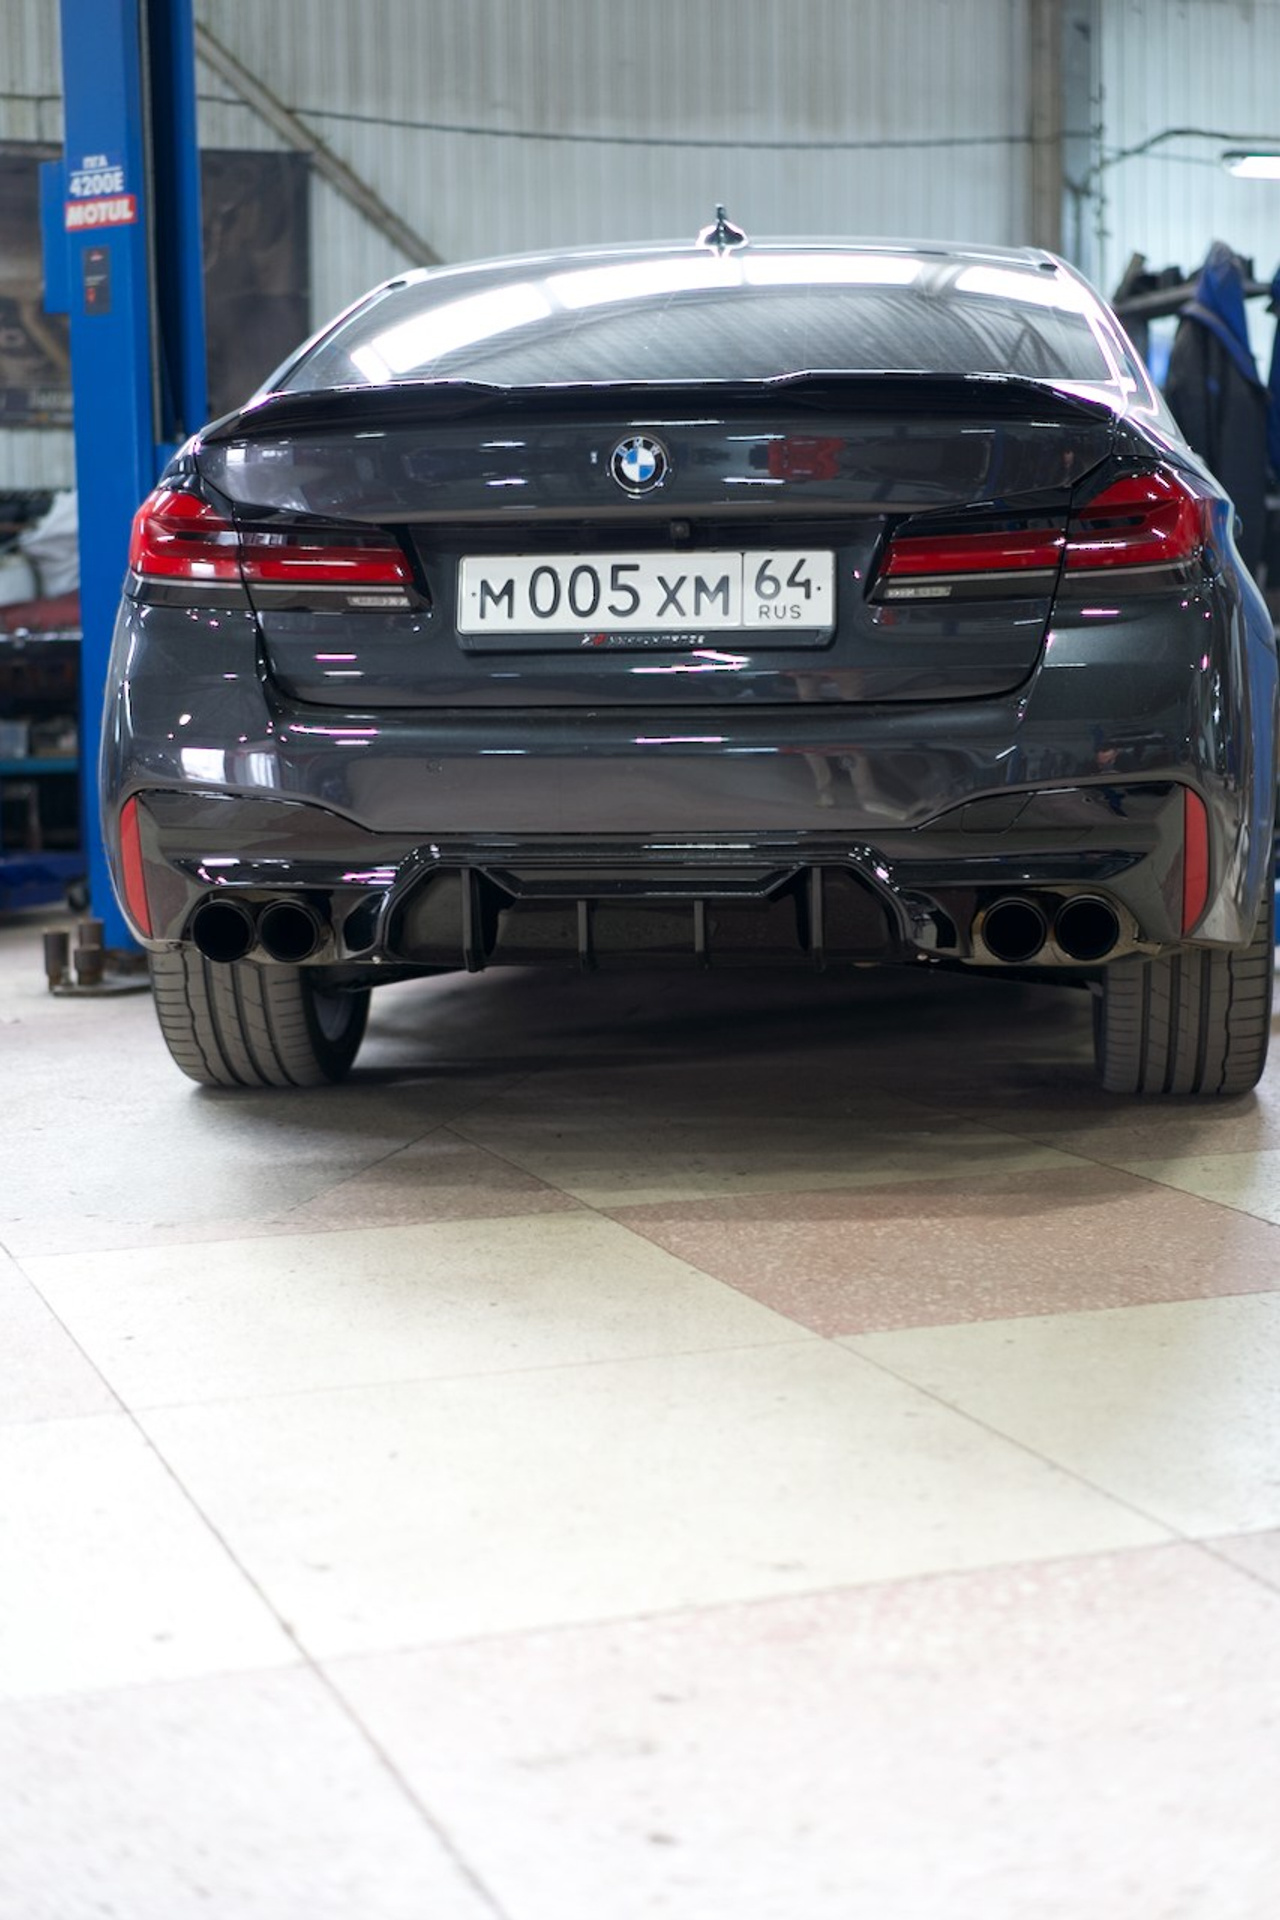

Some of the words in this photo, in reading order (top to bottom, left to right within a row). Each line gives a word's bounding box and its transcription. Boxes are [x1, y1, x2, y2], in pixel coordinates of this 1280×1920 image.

[69, 171, 124, 197] 4200E
[66, 198, 133, 227] MOTUL
[616, 436, 661, 459] BMW
[753, 558, 812, 601] 64
[759, 604, 802, 619] RUS
